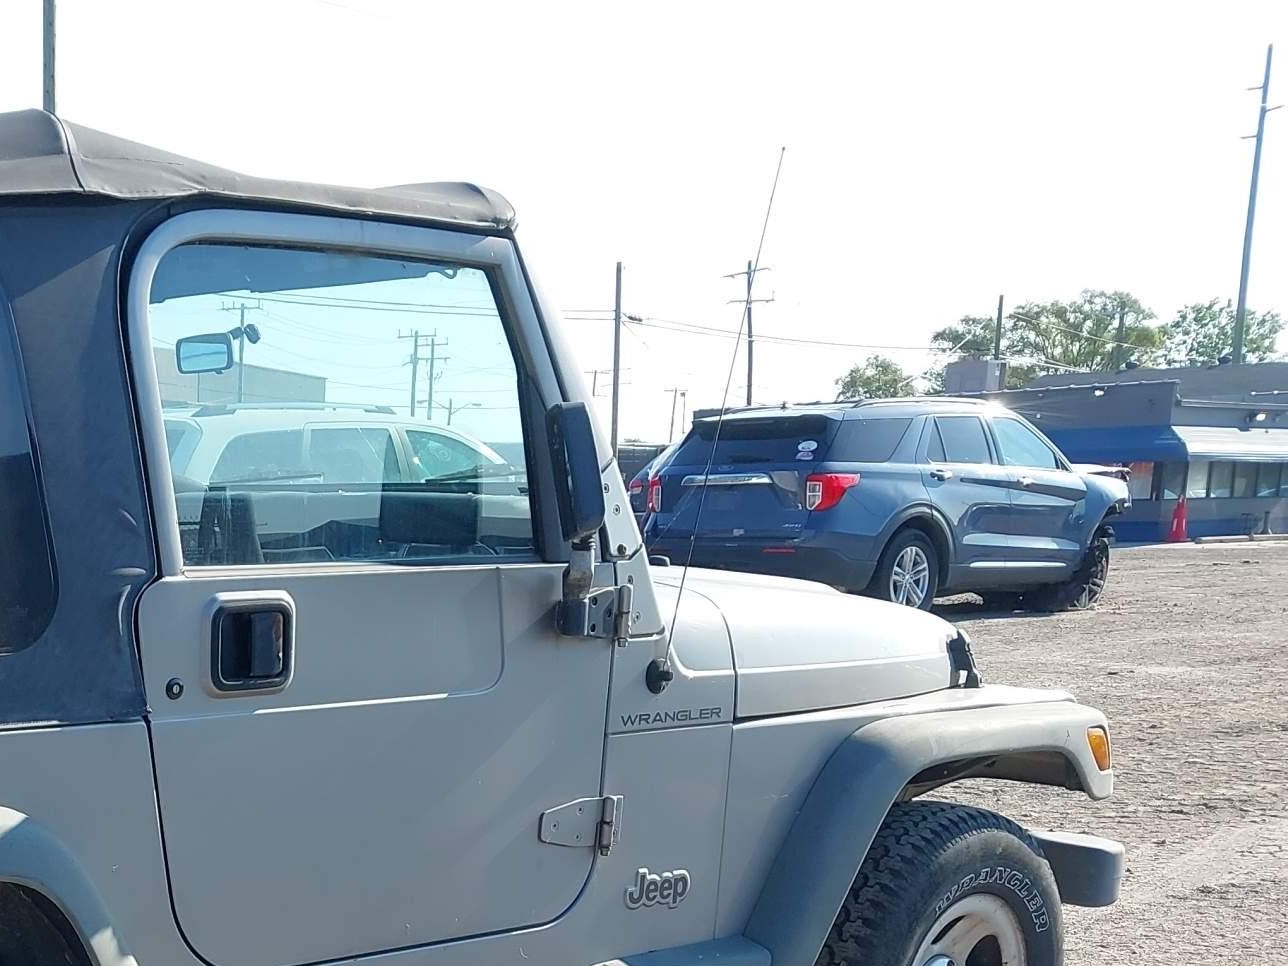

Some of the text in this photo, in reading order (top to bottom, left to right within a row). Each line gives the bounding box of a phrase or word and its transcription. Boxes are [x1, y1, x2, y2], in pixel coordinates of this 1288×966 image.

[621, 707, 722, 727] WRANGLER
[625, 867, 691, 909] Jeep
[935, 866, 1050, 933] WRANGLER
